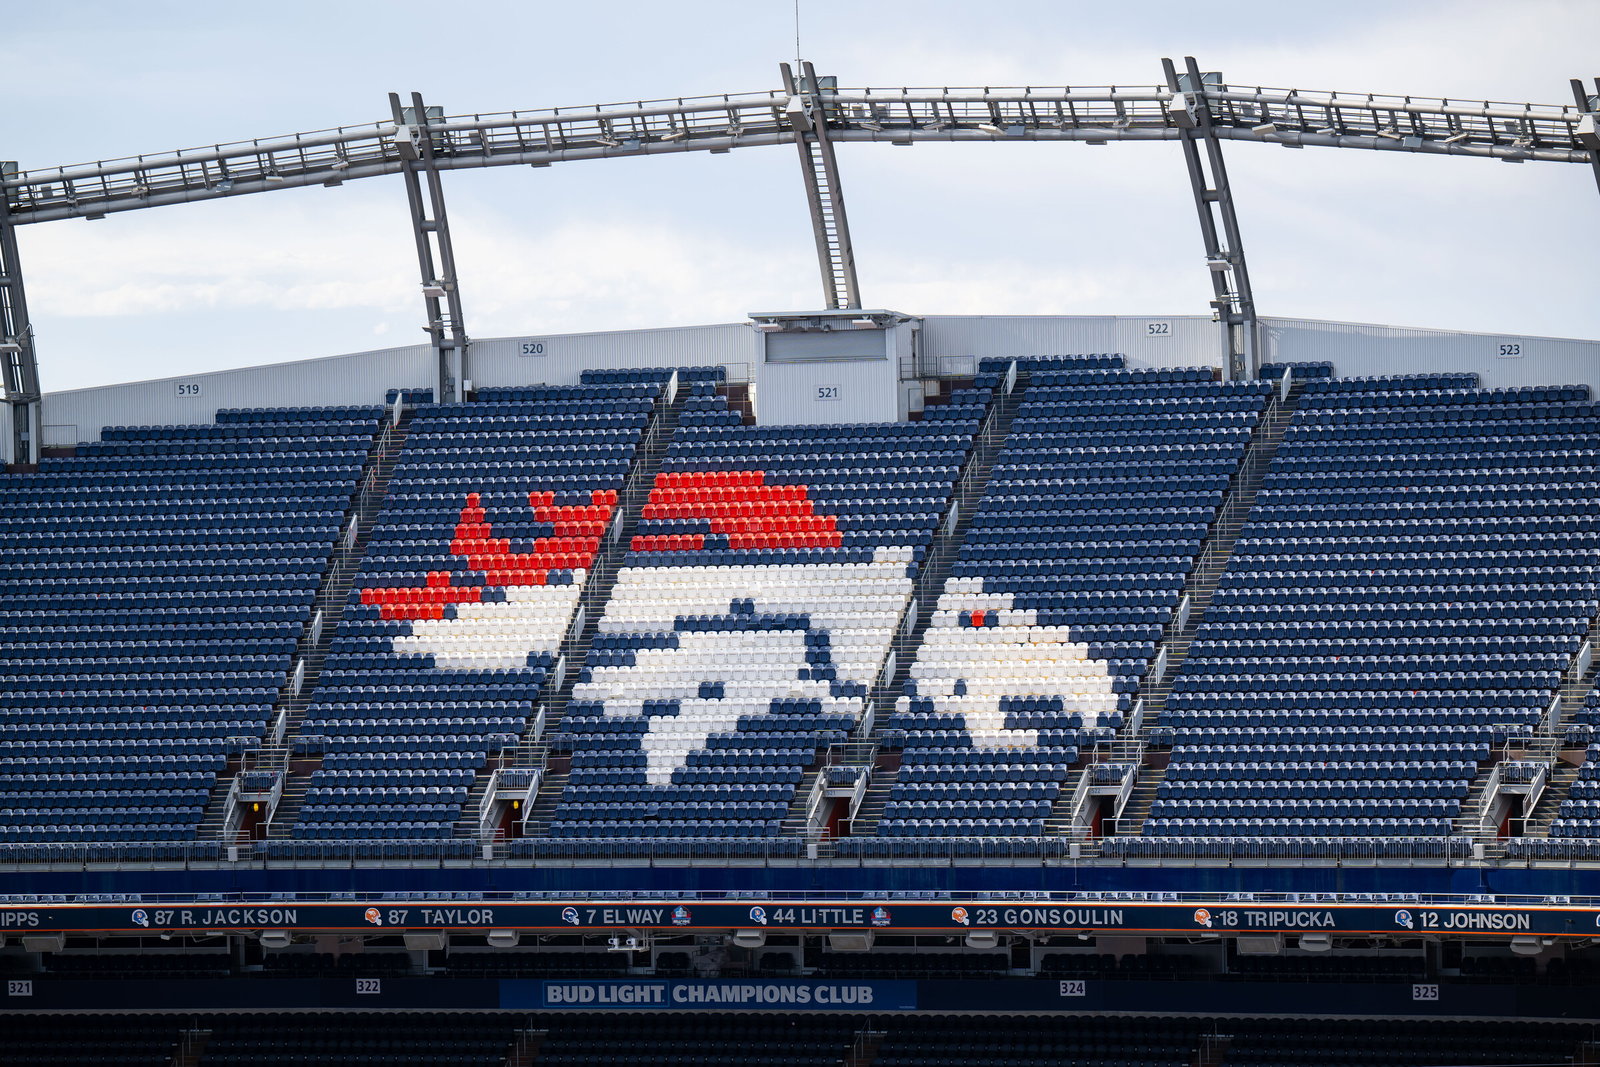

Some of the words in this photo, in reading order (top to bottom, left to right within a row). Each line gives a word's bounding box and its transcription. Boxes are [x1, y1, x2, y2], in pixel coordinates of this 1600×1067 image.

[1148, 323, 1169, 335] 522
[522, 343, 544, 355] 520
[1500, 344, 1521, 356] 523
[178, 384, 199, 395] 519
[818, 387, 838, 399] 521
[1, 912, 40, 927] IPPS
[154, 910, 175, 925] 87
[181, 910, 197, 925] R.
[202, 909, 297, 925] JACKSON
[388, 909, 408, 925] 87
[421, 909, 494, 925] TAYLOR
[586, 909, 597, 924] 7
[603, 909, 664, 924] ELWAY
[773, 908, 796, 924] 44
[801, 908, 864, 924] LITTLE
[976, 909, 998, 925] 23
[1004, 909, 1123, 925] GONSOULIN
[1219, 910, 1239, 926] 18
[1244, 911, 1336, 927] TRIPUCKA
[1419, 911, 1439, 928] 12
[1443, 912, 1530, 930] JOHNSON
[9, 982, 31, 994] 321
[357, 980, 379, 992] 322
[1061, 982, 1084, 994] 324
[1414, 986, 1437, 998] 325
[547, 985, 595, 1003] BUD
[598, 985, 665, 1003] LIGHT
[672, 984, 812, 1004] CHAMPIONS
[814, 985, 874, 1004] CLUB
